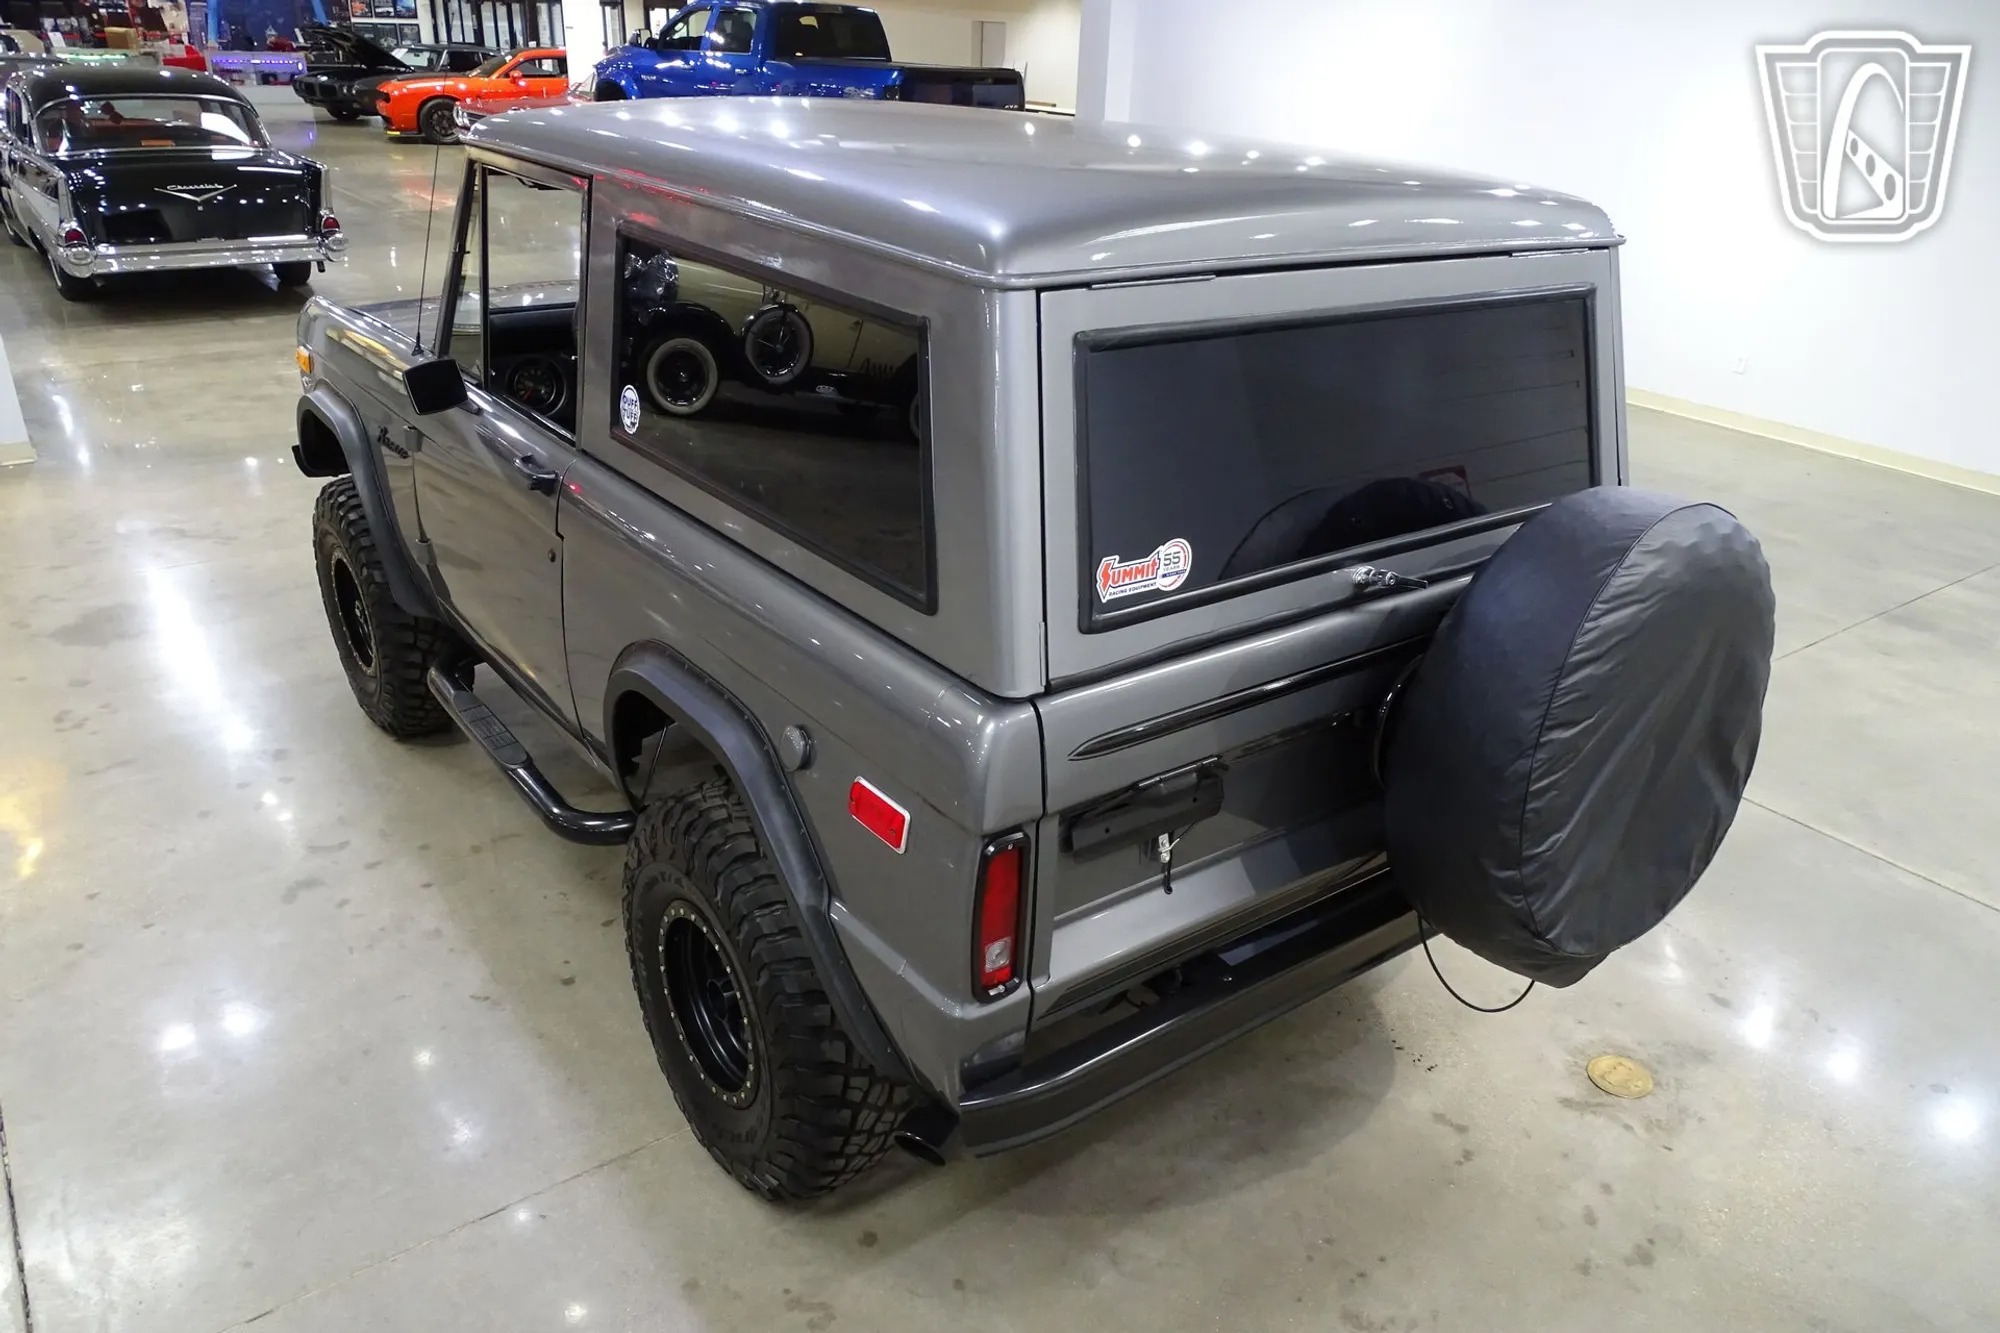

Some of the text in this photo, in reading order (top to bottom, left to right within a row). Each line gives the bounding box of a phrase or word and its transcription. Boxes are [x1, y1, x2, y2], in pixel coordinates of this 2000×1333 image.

[1163, 551, 1181, 567] 55
[1108, 582, 1157, 598] RACING EQUIPMENT
